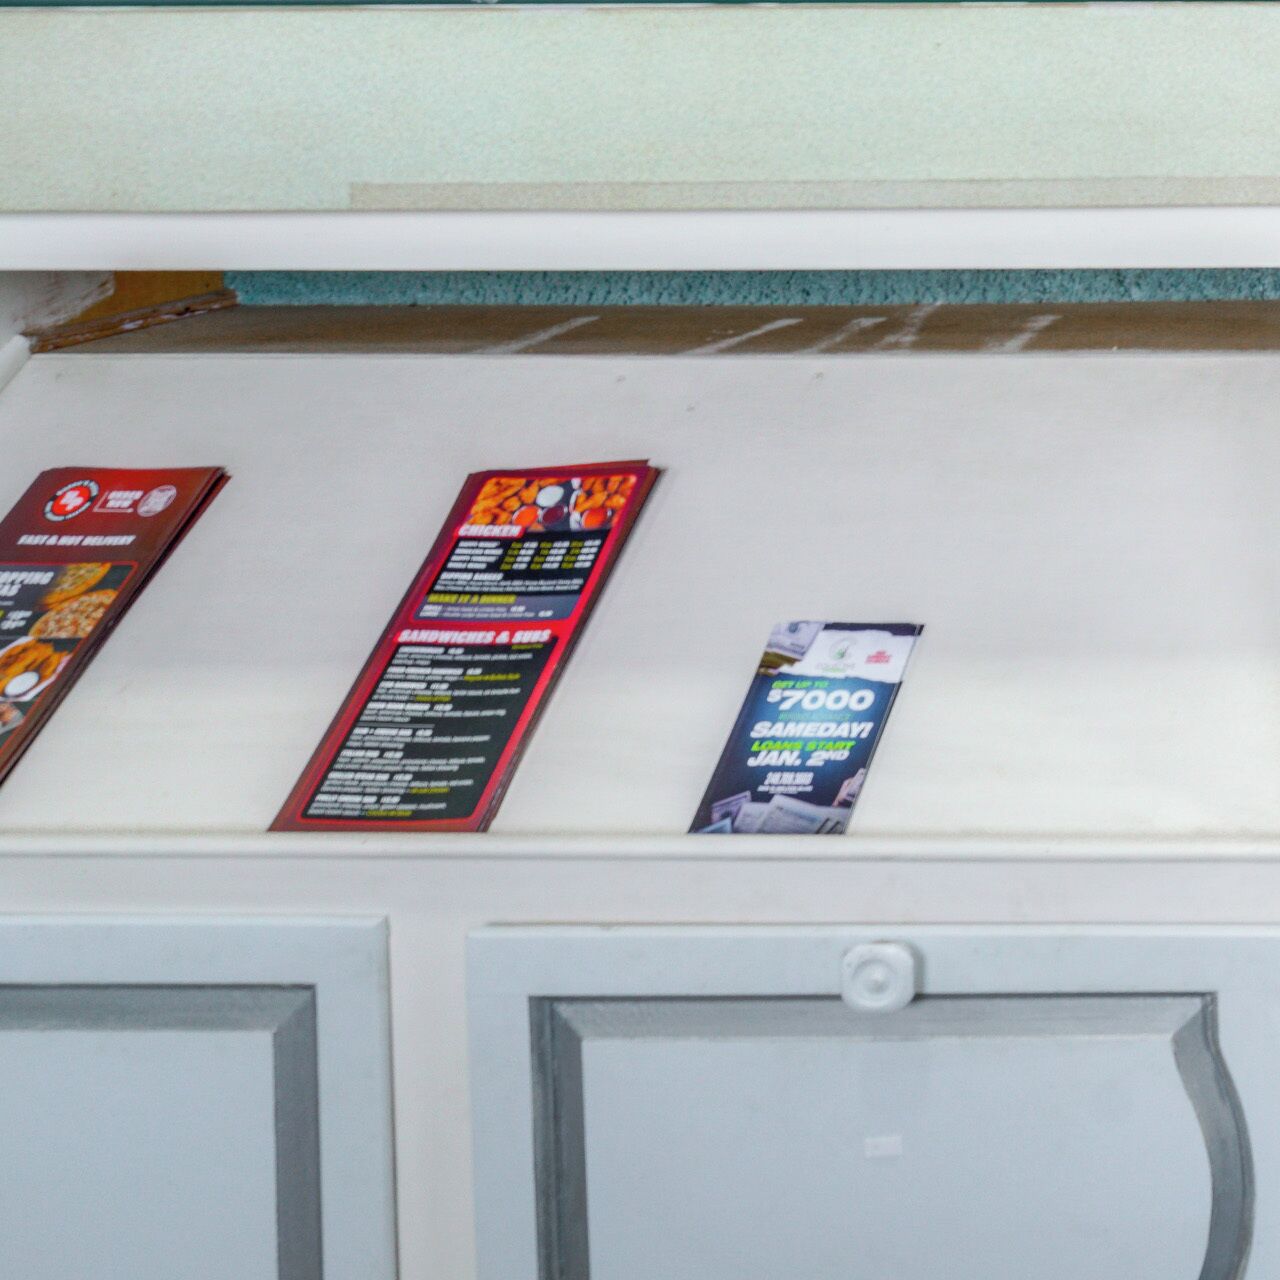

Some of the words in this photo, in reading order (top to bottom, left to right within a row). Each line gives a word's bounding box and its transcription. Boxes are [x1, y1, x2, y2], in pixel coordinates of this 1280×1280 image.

[458, 525, 522, 537] CHICKEN
[17, 535, 49, 545] FAST
[81, 535, 136, 546] DELIVERY
[398, 629, 496, 643] SANDWICHES
[495, 631, 510, 643] &
[511, 629, 551, 643] SUBS
[767, 688, 875, 711] $7000
[750, 721, 874, 738] SAMEDAY!
[751, 740, 802, 751] LOANS
[805, 740, 856, 751] START
[747, 750, 802, 767] JAN.
[805, 750, 850, 766] 2ND
